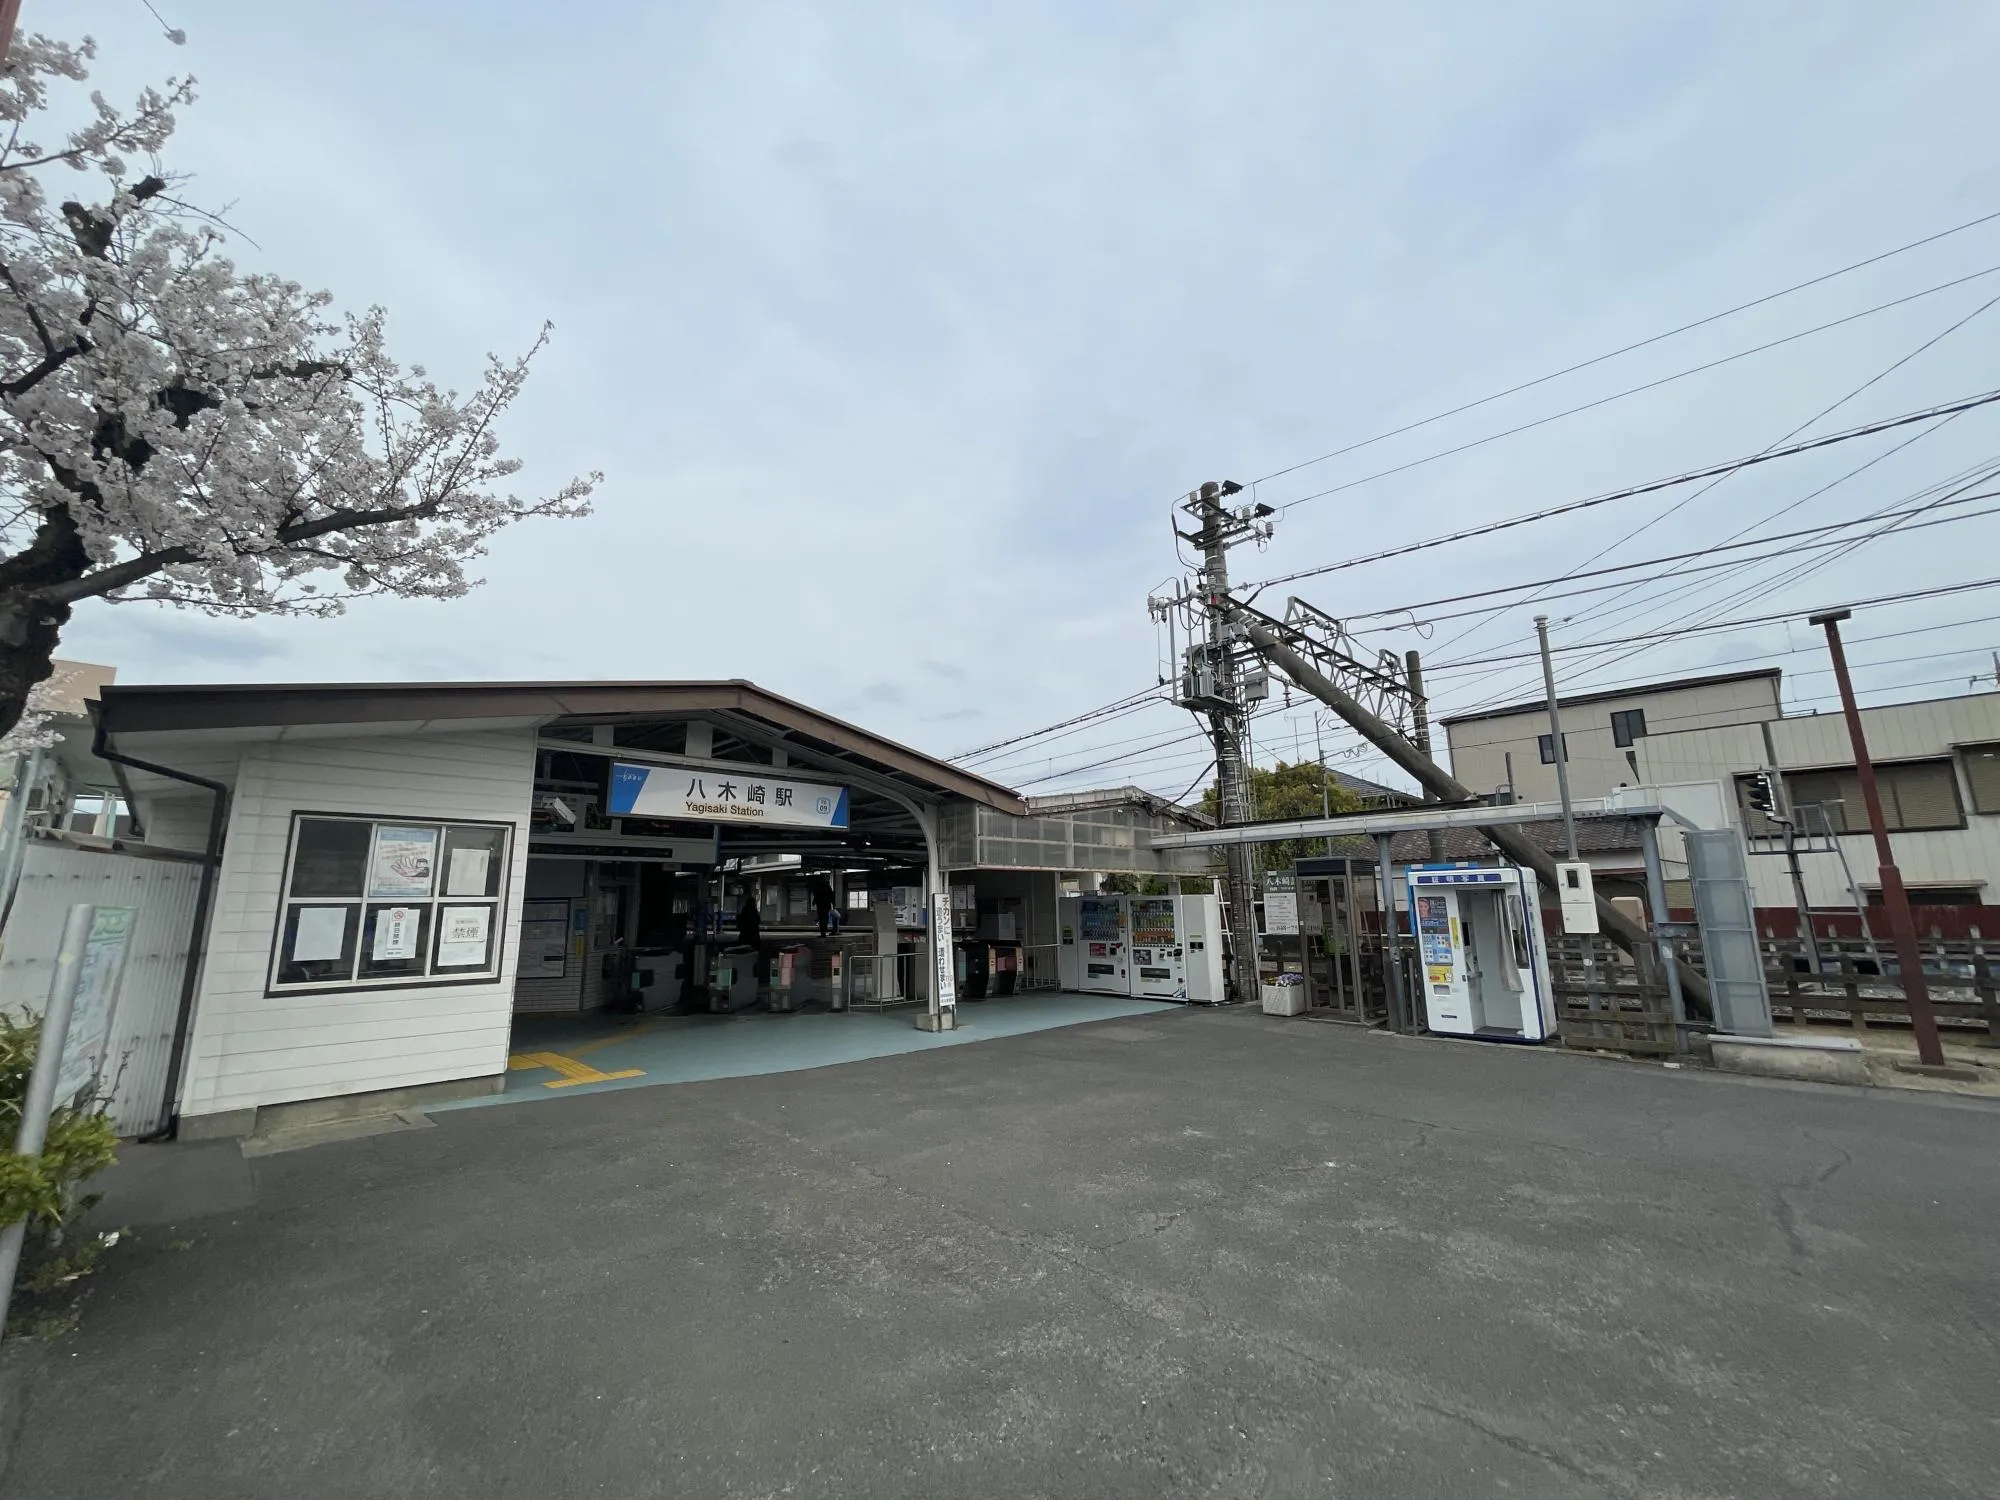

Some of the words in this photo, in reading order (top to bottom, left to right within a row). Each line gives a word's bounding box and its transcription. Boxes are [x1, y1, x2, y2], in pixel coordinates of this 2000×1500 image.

[686, 779, 793, 806] 八木崎駅
[685, 801, 728, 815] Yagisaki
[730, 805, 764, 817] Station
